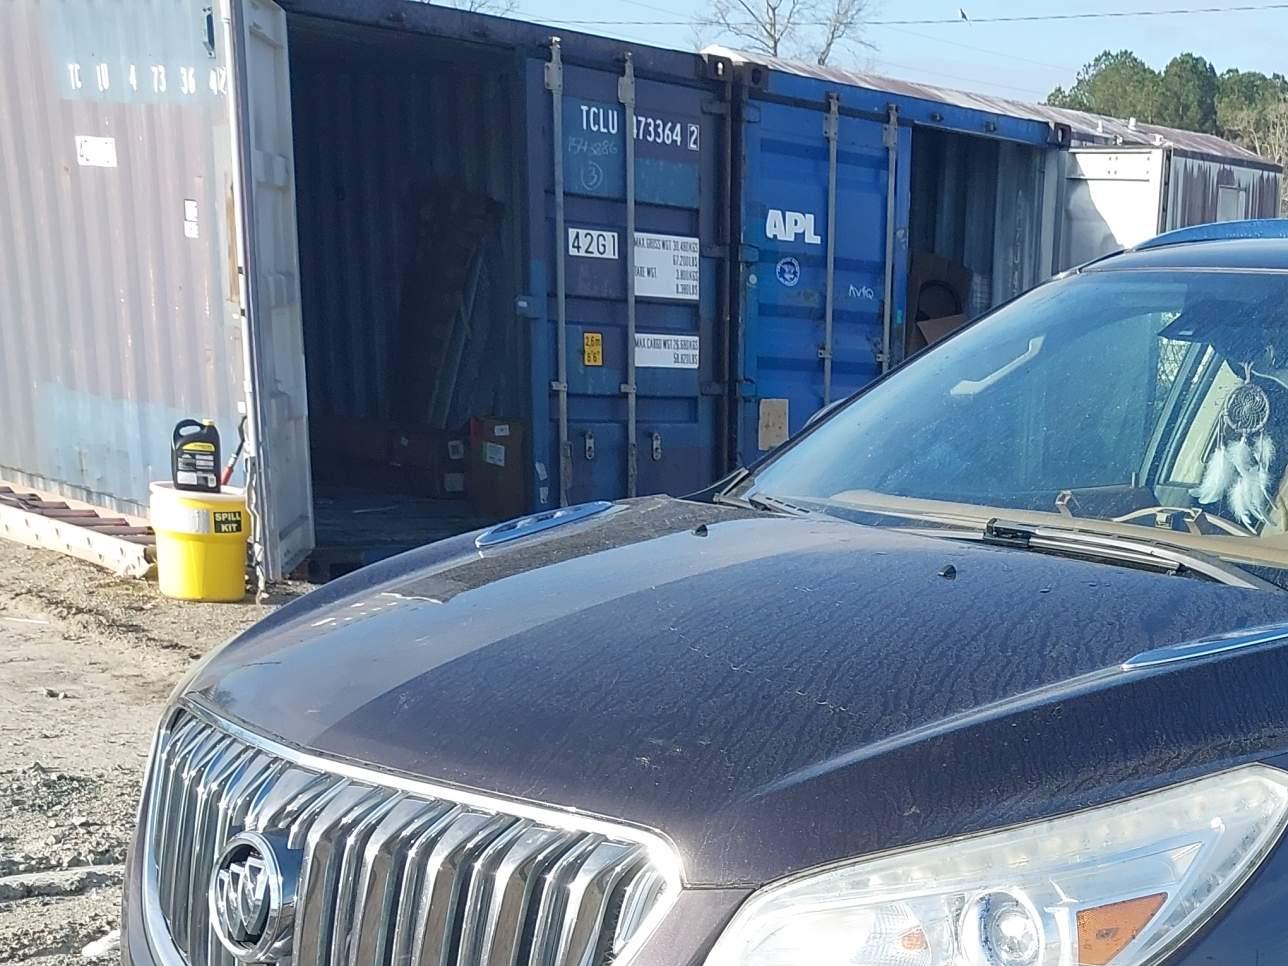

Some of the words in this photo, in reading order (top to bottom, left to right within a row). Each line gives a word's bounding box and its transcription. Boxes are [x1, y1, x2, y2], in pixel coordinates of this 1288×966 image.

[580, 105, 618, 135] TCLU
[688, 125, 698, 149] 2
[766, 209, 821, 244] APL
[571, 231, 616, 257] 42G1
[215, 513, 241, 521] SPILL
[221, 523, 238, 533] KIT
